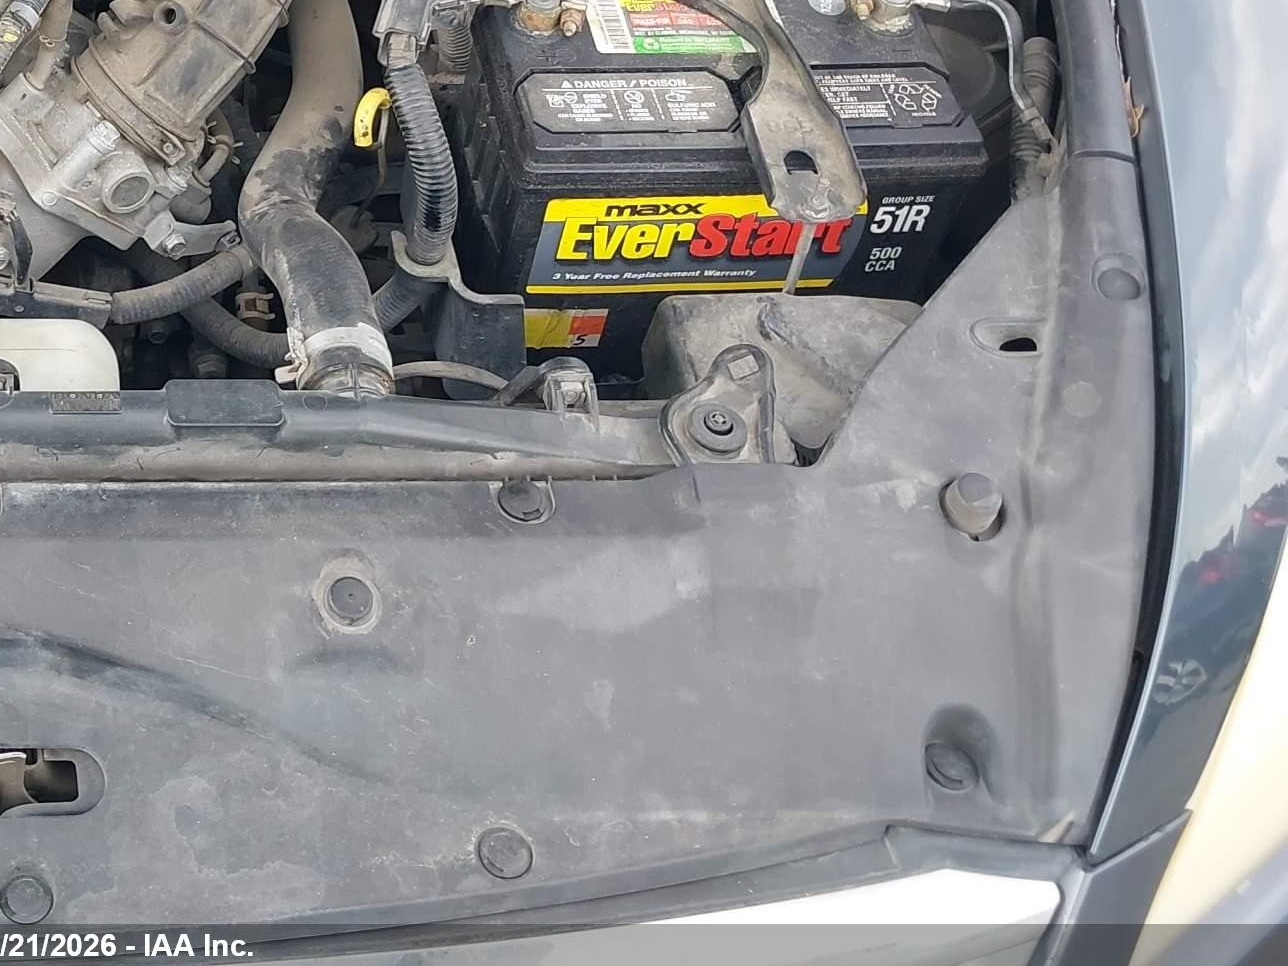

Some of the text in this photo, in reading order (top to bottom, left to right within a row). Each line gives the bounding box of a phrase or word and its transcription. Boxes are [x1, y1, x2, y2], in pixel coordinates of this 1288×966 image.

[574, 80, 627, 88] DANGER
[639, 79, 687, 87] POISON
[882, 195, 935, 204] GROUP SIZE
[604, 202, 705, 217] maxx
[869, 204, 931, 234] 51R
[869, 246, 902, 260] 500
[864, 260, 896, 273] CCA
[552, 269, 757, 281] 3 Year Free Replacement Warranty
